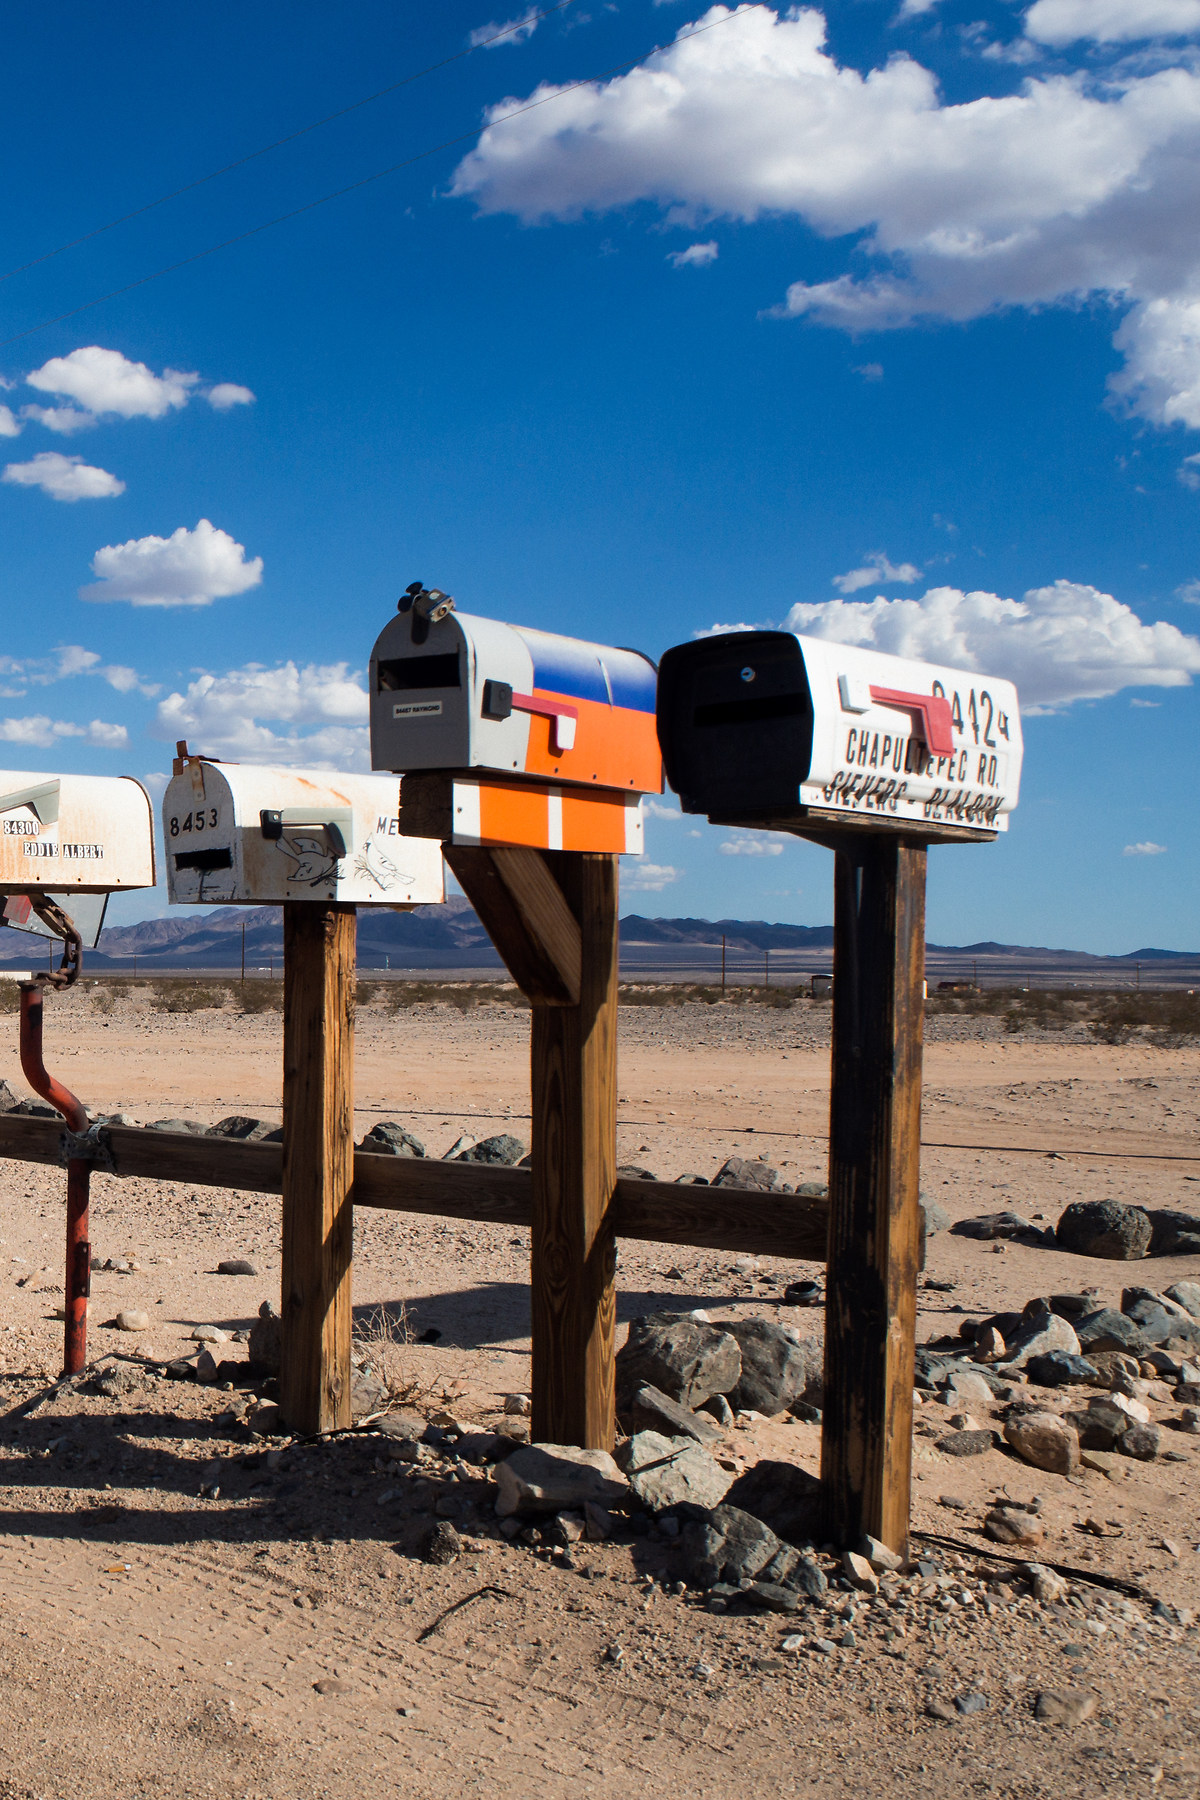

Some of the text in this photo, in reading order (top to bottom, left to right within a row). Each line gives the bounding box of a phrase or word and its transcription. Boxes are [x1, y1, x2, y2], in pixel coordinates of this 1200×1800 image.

[3, 820, 40, 835] 84300
[170, 808, 218, 837] 8453
[23, 841, 104, 859] EDDIE ALBERT
